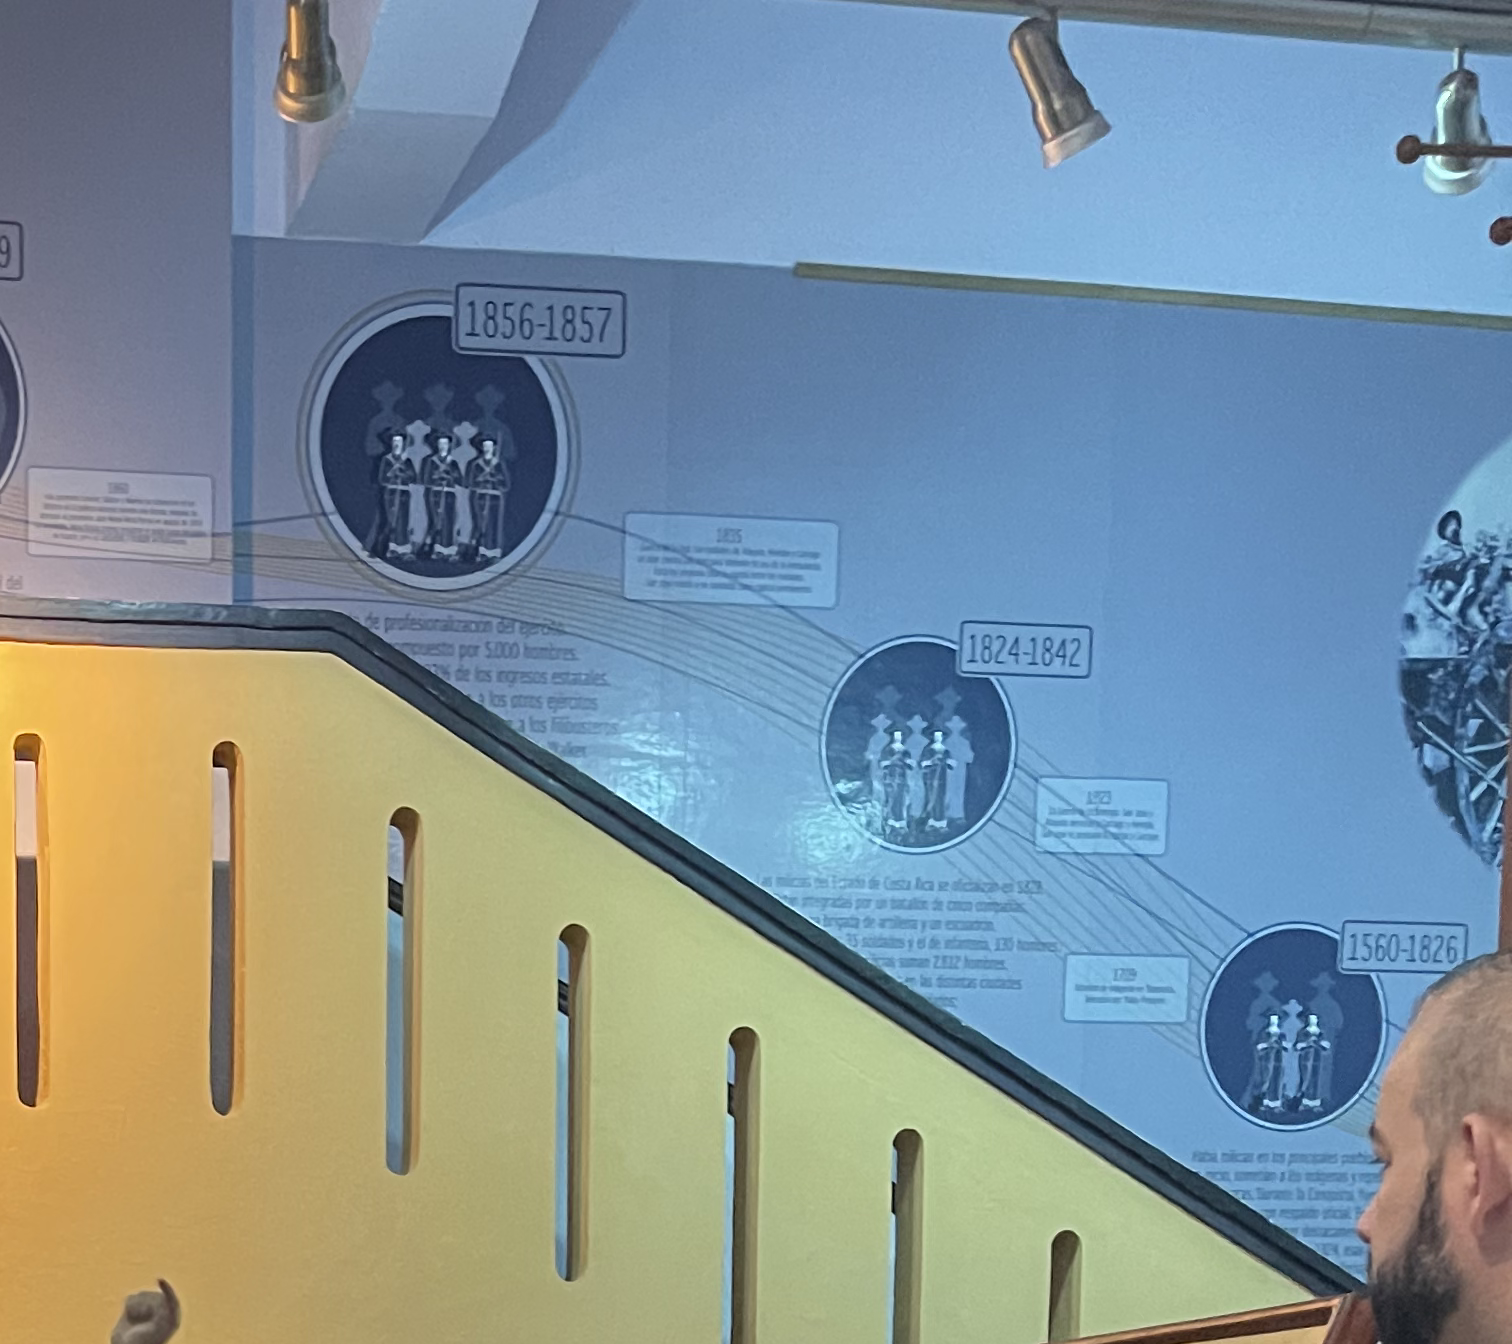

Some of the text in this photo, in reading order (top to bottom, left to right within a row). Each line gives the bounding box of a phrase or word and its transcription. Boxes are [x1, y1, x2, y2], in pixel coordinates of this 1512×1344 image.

[464, 300, 612, 344] 1856-1857
[485, 641, 521, 660] 5.000
[966, 633, 1082, 668] 1824-1842
[1346, 932, 1458, 964] 1560-1826
